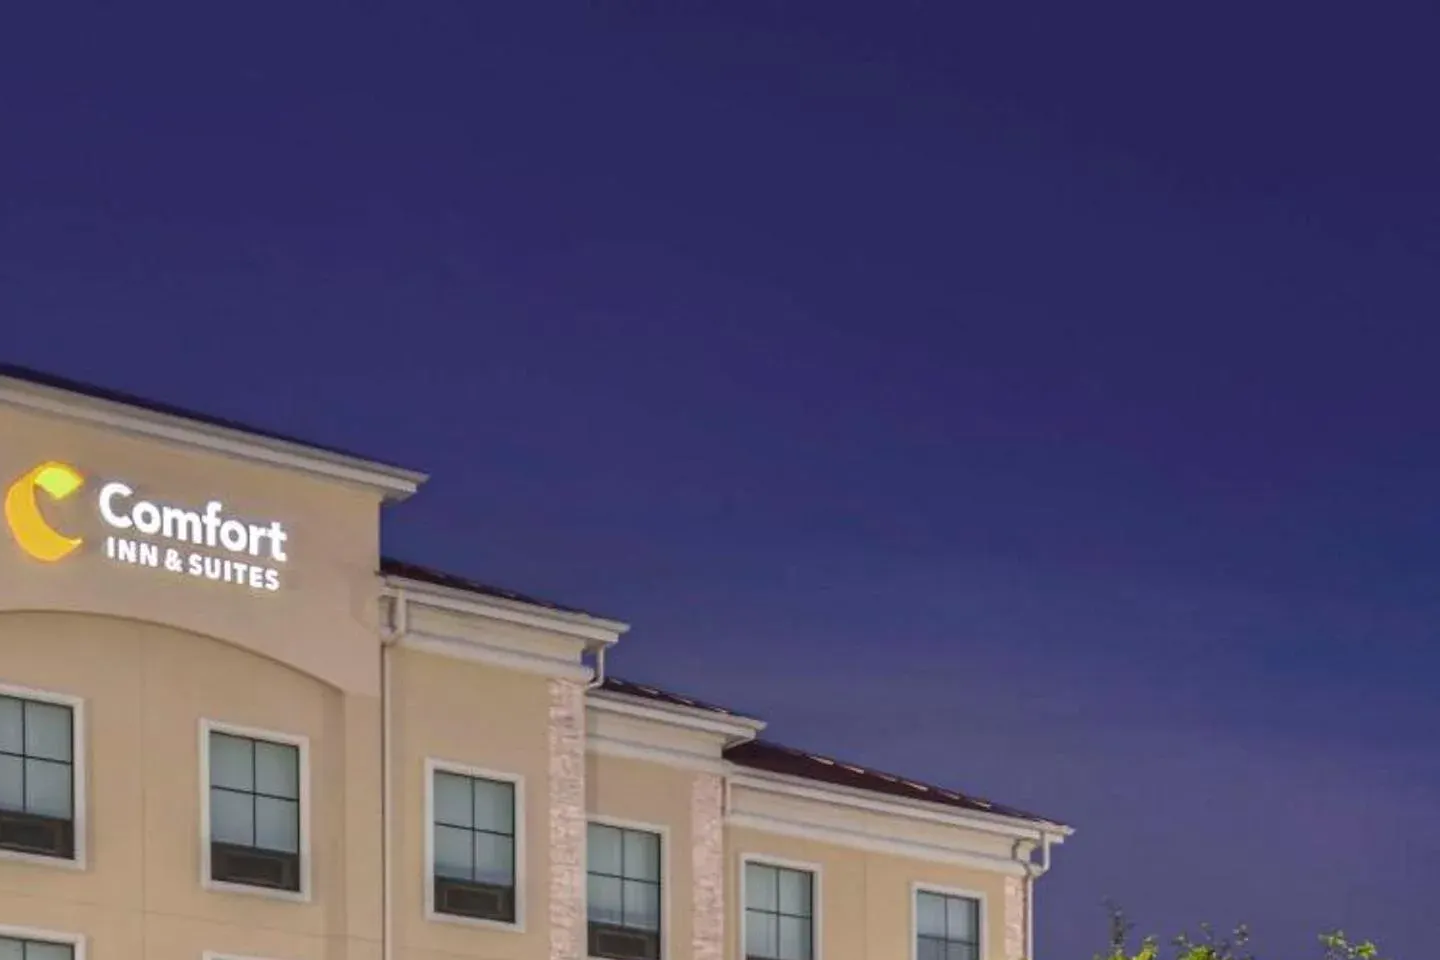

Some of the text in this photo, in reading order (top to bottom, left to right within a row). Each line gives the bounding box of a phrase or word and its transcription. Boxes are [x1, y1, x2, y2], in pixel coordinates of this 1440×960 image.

[98, 482, 288, 562] Comfort
[106, 536, 281, 591] INN & SUITES
